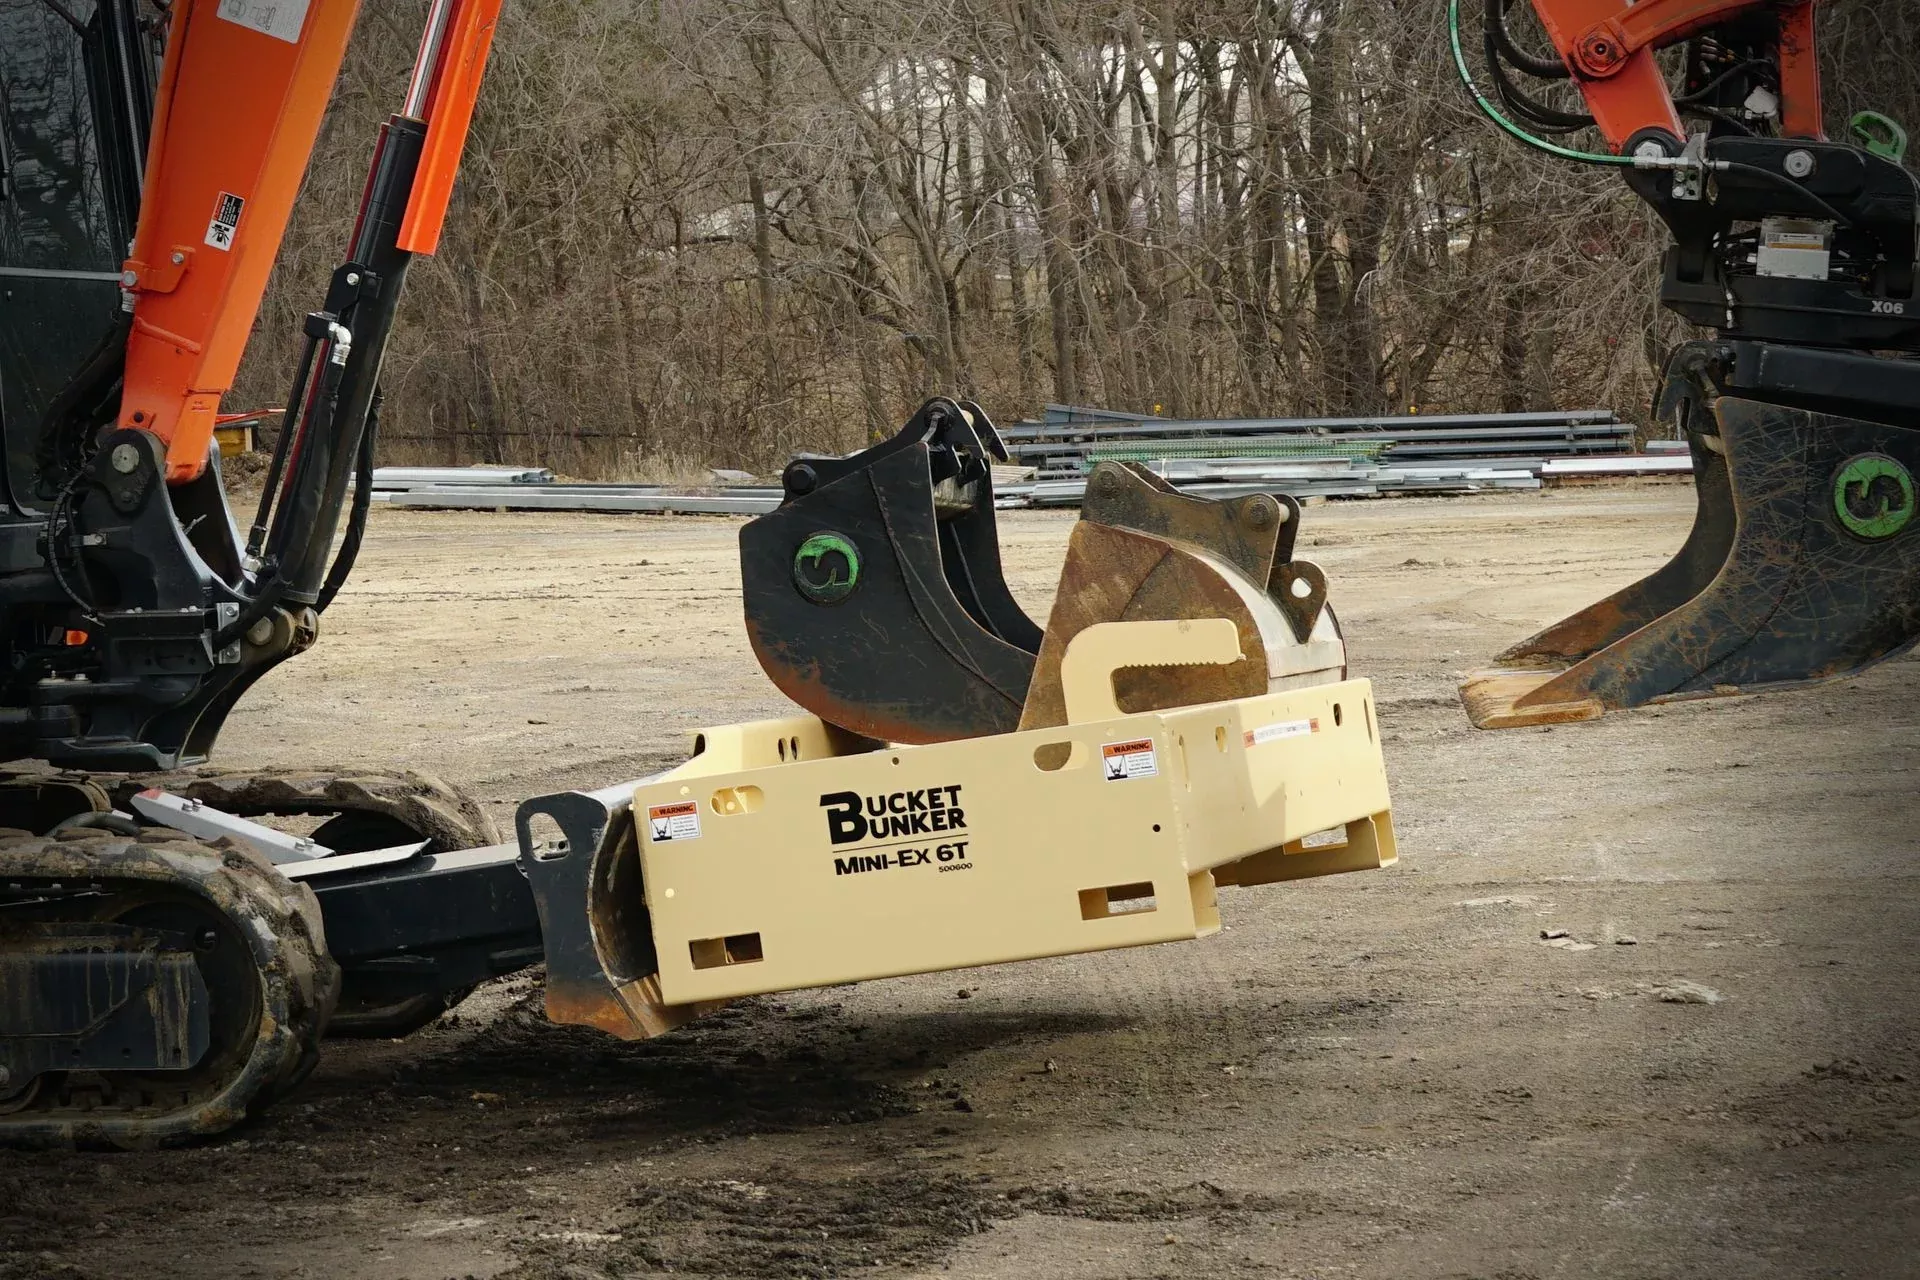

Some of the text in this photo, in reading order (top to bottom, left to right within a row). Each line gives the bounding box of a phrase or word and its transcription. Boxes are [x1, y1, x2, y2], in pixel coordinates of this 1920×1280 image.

[1871, 300, 1904, 314] X06
[1113, 741, 1150, 753] WARNING
[658, 804, 694, 815] WARNING
[819, 784, 962, 845] BUCKET
[819, 791, 968, 845] BUNKER
[834, 841, 969, 875] MINI-EX 6T
